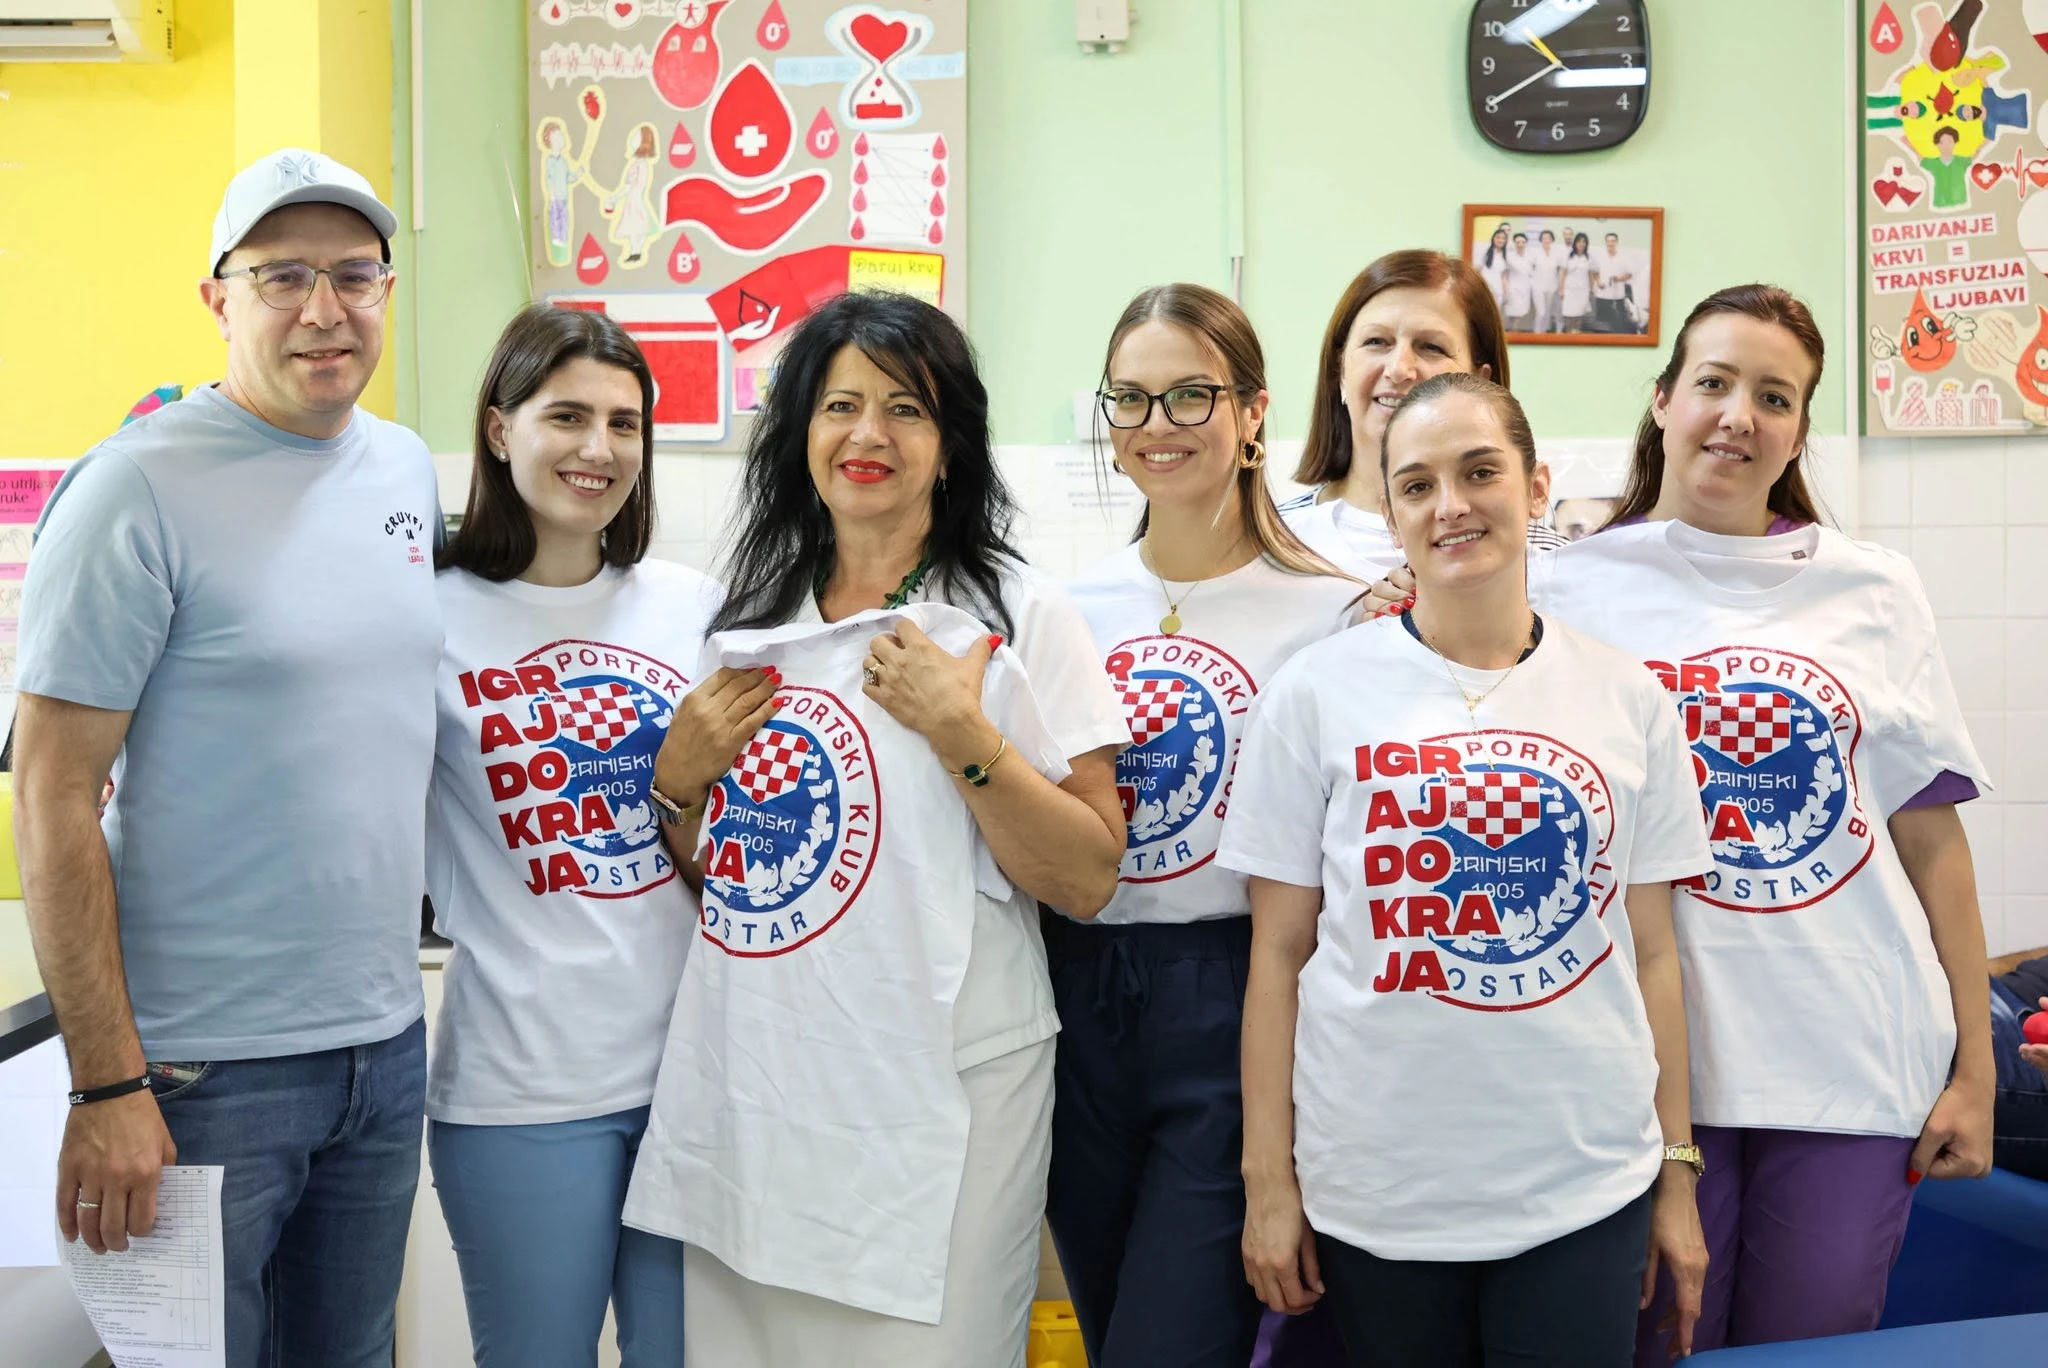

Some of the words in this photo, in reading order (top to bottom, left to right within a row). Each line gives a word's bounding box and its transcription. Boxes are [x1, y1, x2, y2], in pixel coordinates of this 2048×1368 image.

[1483, 21, 1506, 38] 10
[1616, 15, 1631, 32] 2
[1482, 57, 1496, 75] 9
[1620, 53, 1633, 69] 3
[1485, 94, 1499, 114] 8
[1616, 92, 1630, 110] 4
[1514, 120, 1528, 139] 7
[1551, 122, 1565, 141] 6
[1587, 118, 1601, 137] 5
[1872, 217, 1994, 243] DARIVANJE
[1872, 247, 1924, 268] KRVI
[1875, 262, 2025, 290] TRANSFUZIJA
[1933, 286, 2026, 310] LJUBAVI
[458, 664, 563, 708] IGR
[532, 648, 683, 699] PORTSK
[1125, 644, 1249, 716] PORTSKI
[1703, 656, 1850, 732] PORTSKI
[480, 703, 558, 754] AJ
[485, 750, 569, 803] DO
[1116, 752, 1178, 770] RINJSKI
[1355, 741, 1465, 782] IGR
[1441, 740, 1606, 815] PORTSKI
[780, 696, 864, 782] PORTSKI
[830, 804, 870, 894] KLUB
[1365, 786, 1448, 834] AJ
[498, 794, 617, 850] KRA
[524, 851, 589, 896] JA
[584, 853, 671, 887] OSTA
[1364, 839, 1452, 887] DO
[1706, 861, 1833, 900] OSTAR
[705, 904, 808, 944] OSTAR
[1369, 894, 1502, 940] KRA
[1373, 950, 1450, 993] JA
[1448, 948, 1581, 998] OSTAR
